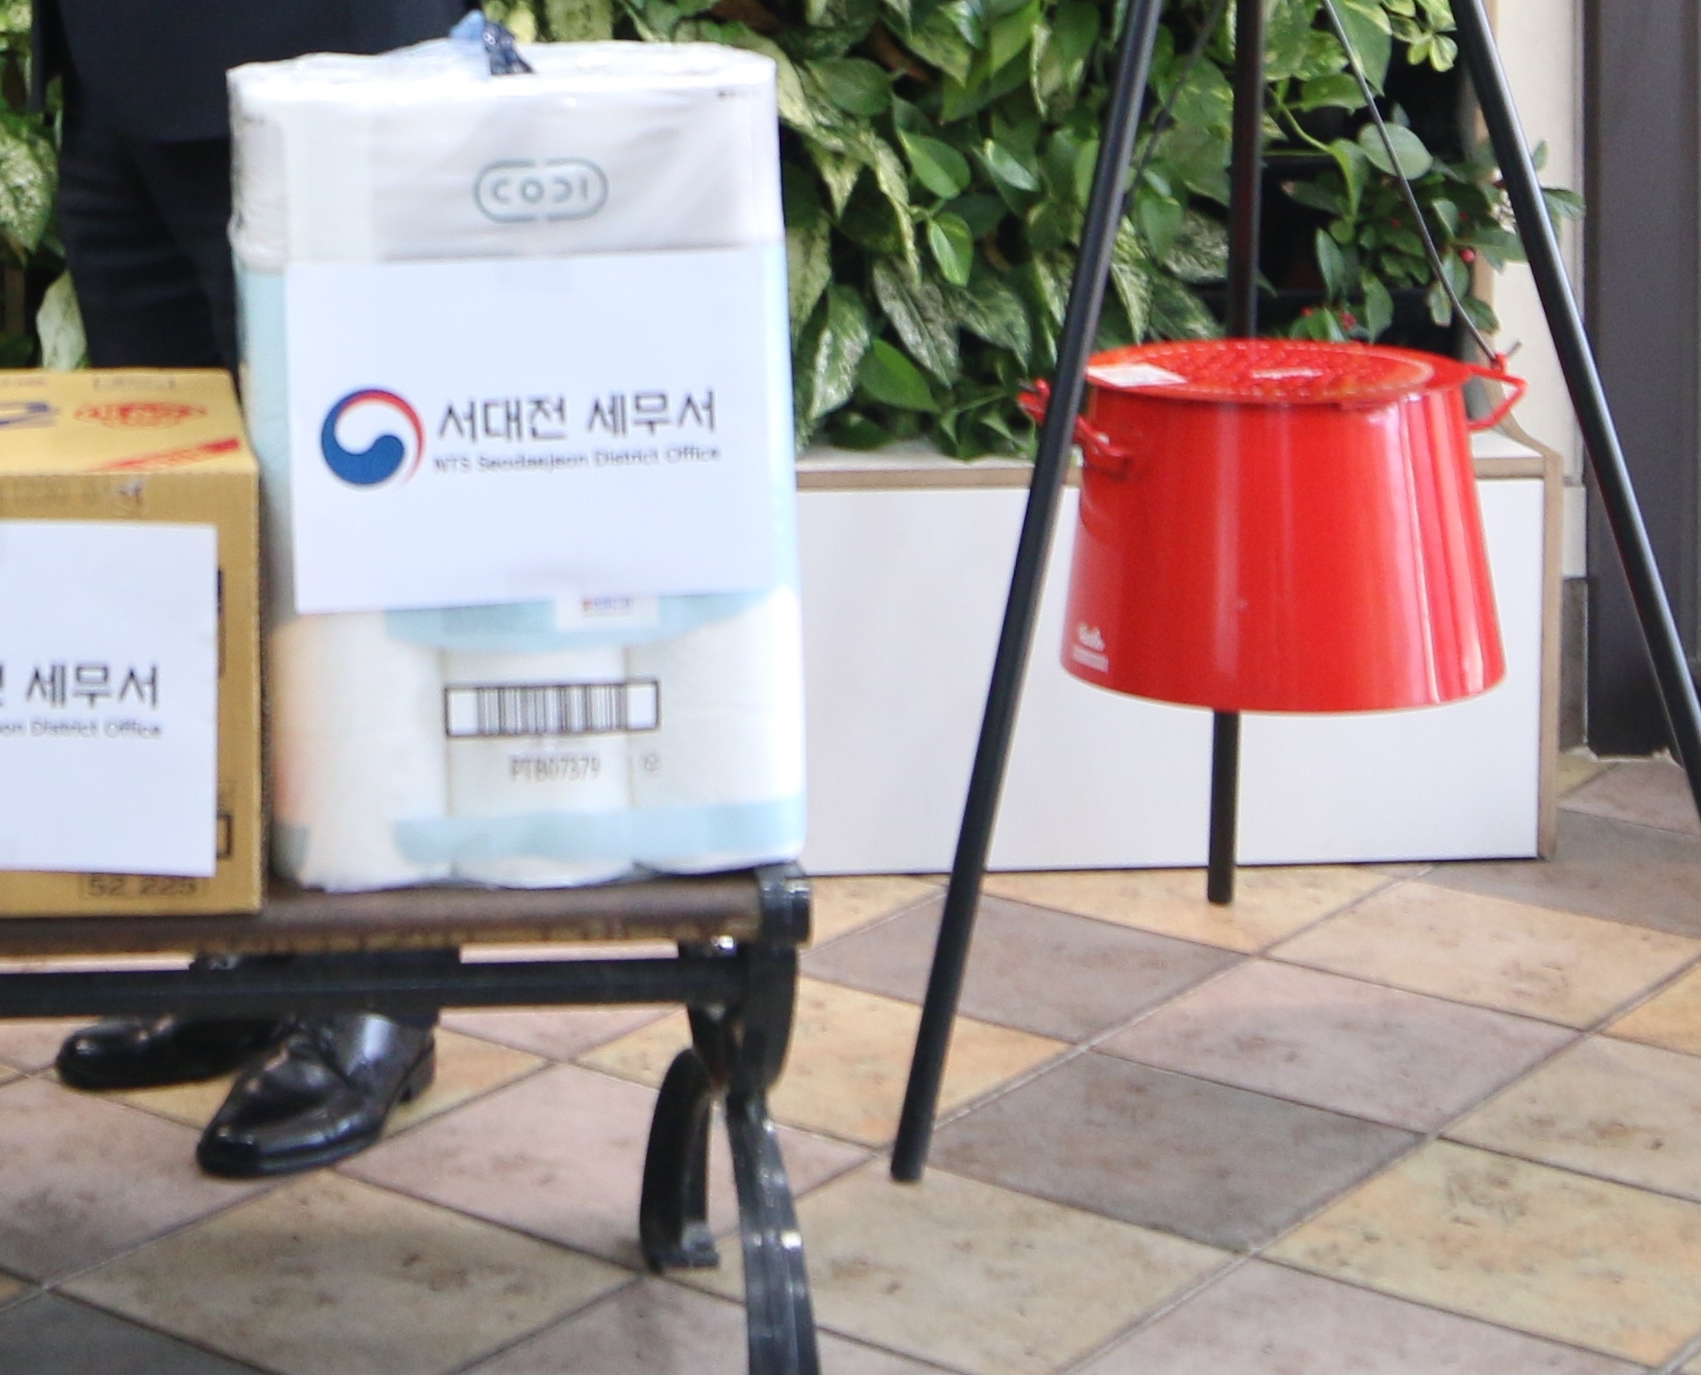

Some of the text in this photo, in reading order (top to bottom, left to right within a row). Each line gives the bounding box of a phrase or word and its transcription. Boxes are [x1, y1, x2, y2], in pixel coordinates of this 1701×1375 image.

[438, 386, 716, 443] 서대전 세무서
[666, 444, 720, 463] Office
[26, 664, 158, 709] 세무서
